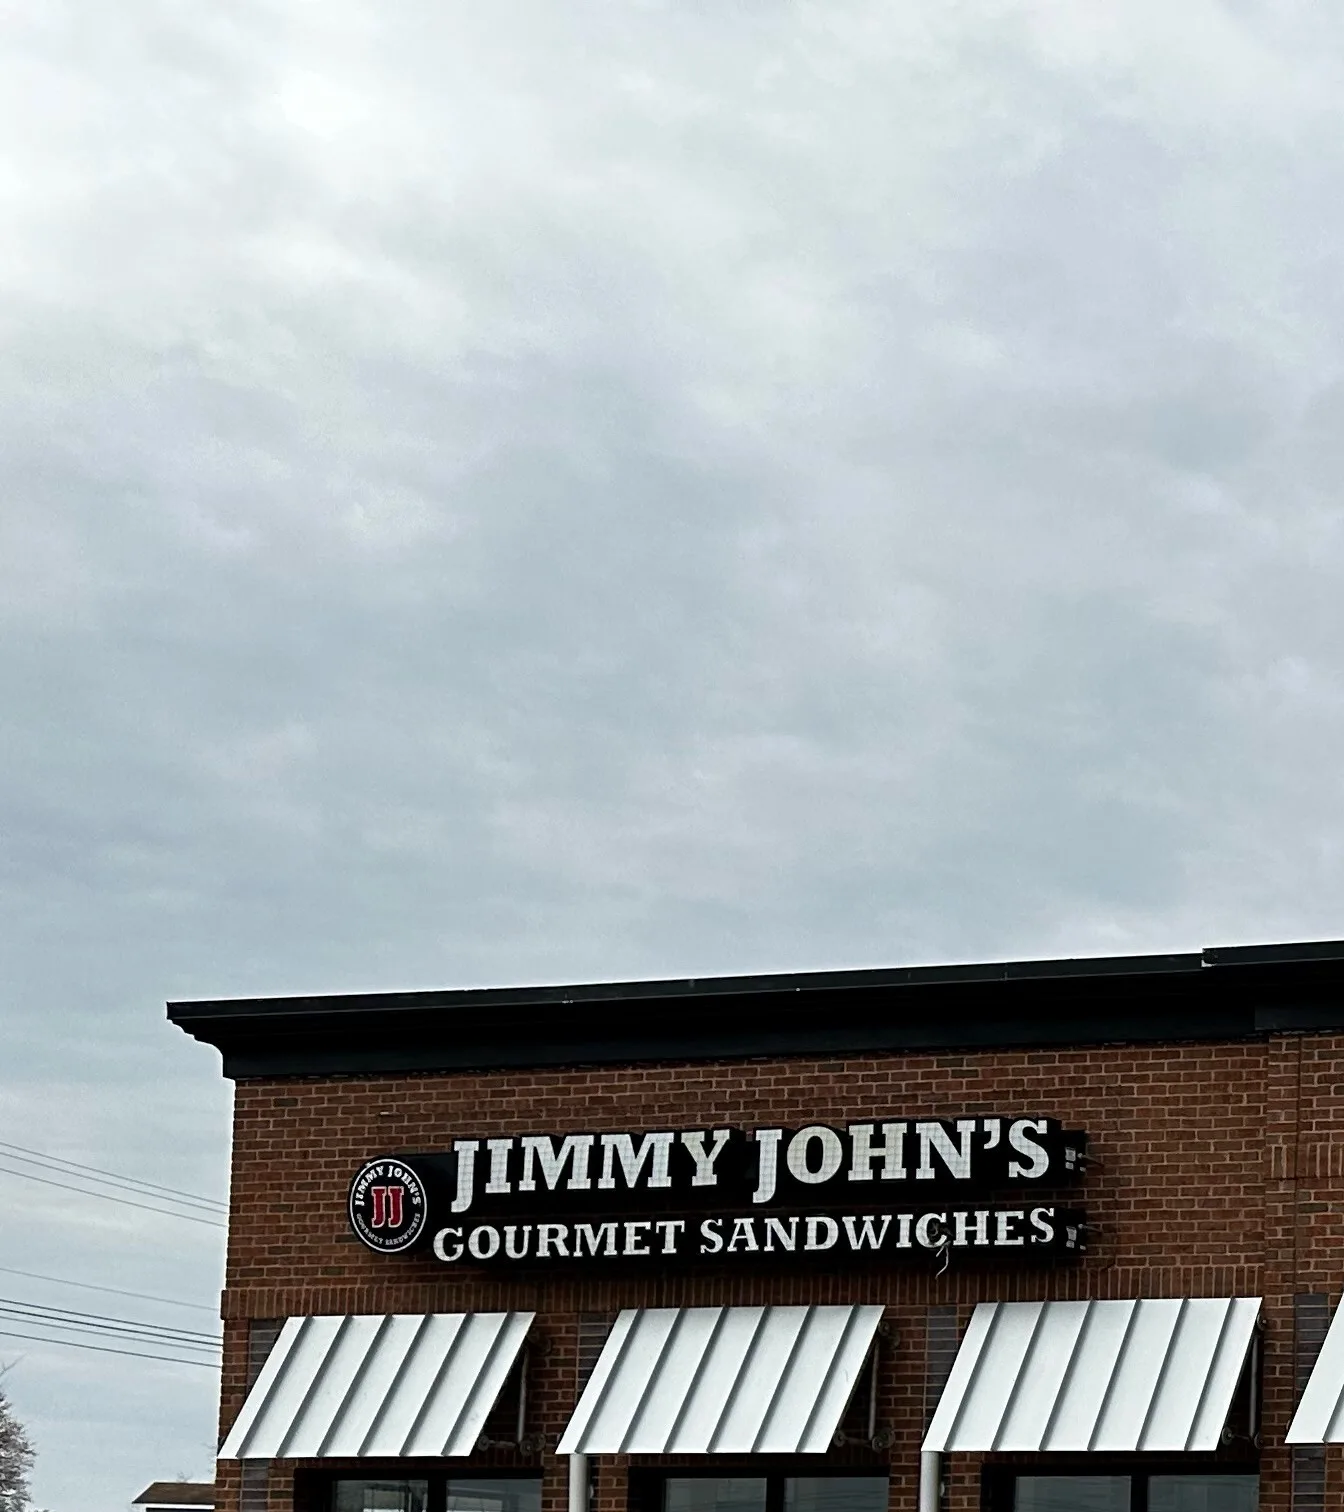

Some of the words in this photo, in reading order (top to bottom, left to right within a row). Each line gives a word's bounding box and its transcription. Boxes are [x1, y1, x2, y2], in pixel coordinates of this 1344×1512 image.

[354, 1165, 384, 1206] JIMMY
[387, 1165, 422, 1206] JOHN'S
[450, 1130, 728, 1213] JIMMY
[752, 1117, 1053, 1205] JOHN'S
[371, 1186, 405, 1228] JJ
[433, 1219, 686, 1262] GOURMET
[700, 1207, 1057, 1256] SANDWICHES
